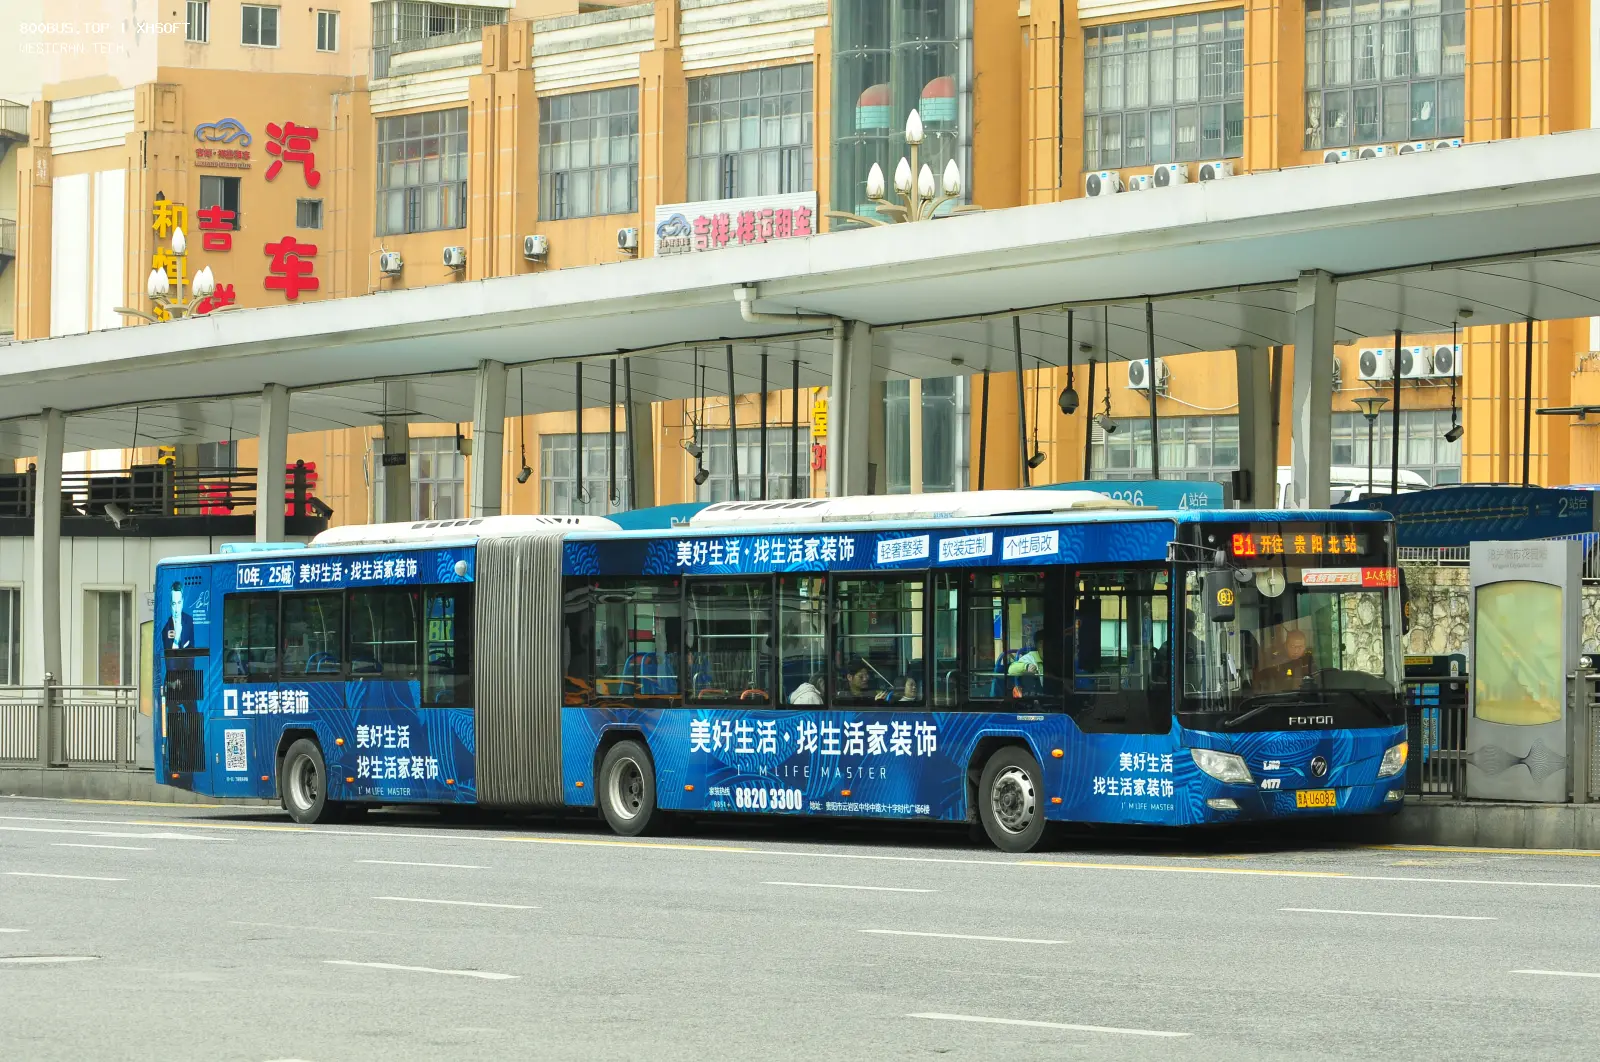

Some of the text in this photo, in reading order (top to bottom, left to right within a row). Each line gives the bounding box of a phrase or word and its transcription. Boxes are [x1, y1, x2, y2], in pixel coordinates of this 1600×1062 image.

[264, 121, 321, 300] 汽车
[676, 537, 855, 567] 美好生活·找生活家装饰
[880, 538, 924, 560] 轻奢整装
[942, 535, 987, 557] 软装定制
[1006, 533, 1052, 554] 个性局改
[1233, 533, 1356, 555] B1 开往 贵阳北站
[299, 558, 417, 583] 美好生活·找生活家装饰
[241, 689, 309, 715] 生活家装饰
[1288, 714, 1334, 726] FOTON
[356, 724, 410, 749] 美好生活
[690, 719, 937, 757] 美好生活·找生活家装饰
[356, 756, 438, 780] 找生活家装饰
[775, 765, 810, 779] LIFE
[821, 766, 888, 780] MASTER
[1119, 751, 1174, 774] 美好生活
[372, 787, 385, 796] LIFE
[387, 787, 411, 797] MASTER
[1093, 776, 1174, 799] 找生活家装饰
[1260, 778, 1281, 790] 4177
[736, 787, 803, 811] 8820 3300
[1134, 802, 1148, 811] LIFE
[1150, 803, 1174, 811] MASTER
